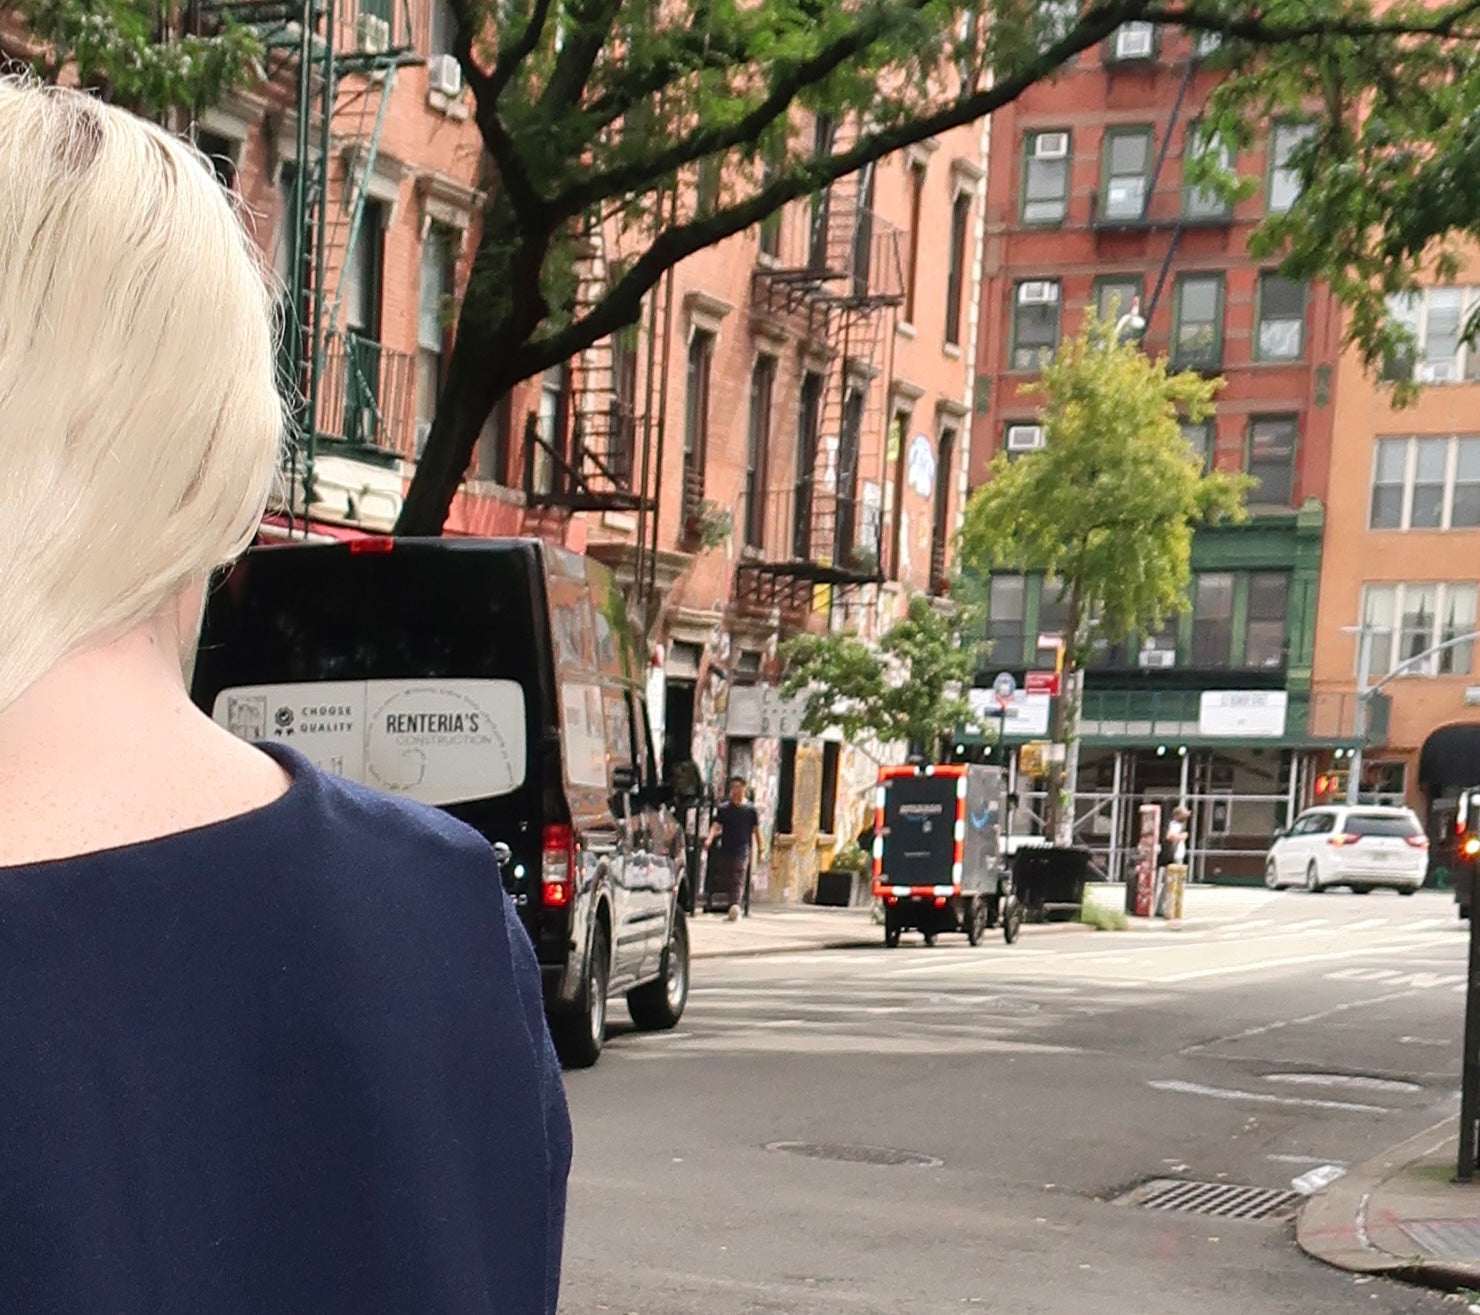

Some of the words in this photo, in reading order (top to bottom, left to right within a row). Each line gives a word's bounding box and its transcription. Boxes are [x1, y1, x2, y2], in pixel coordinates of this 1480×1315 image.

[301, 705, 352, 716] CHOOSE
[300, 722, 353, 733] QUALITY
[386, 712, 479, 733] RENTERIA'S
[396, 735, 492, 746] CONSTRUCTION
